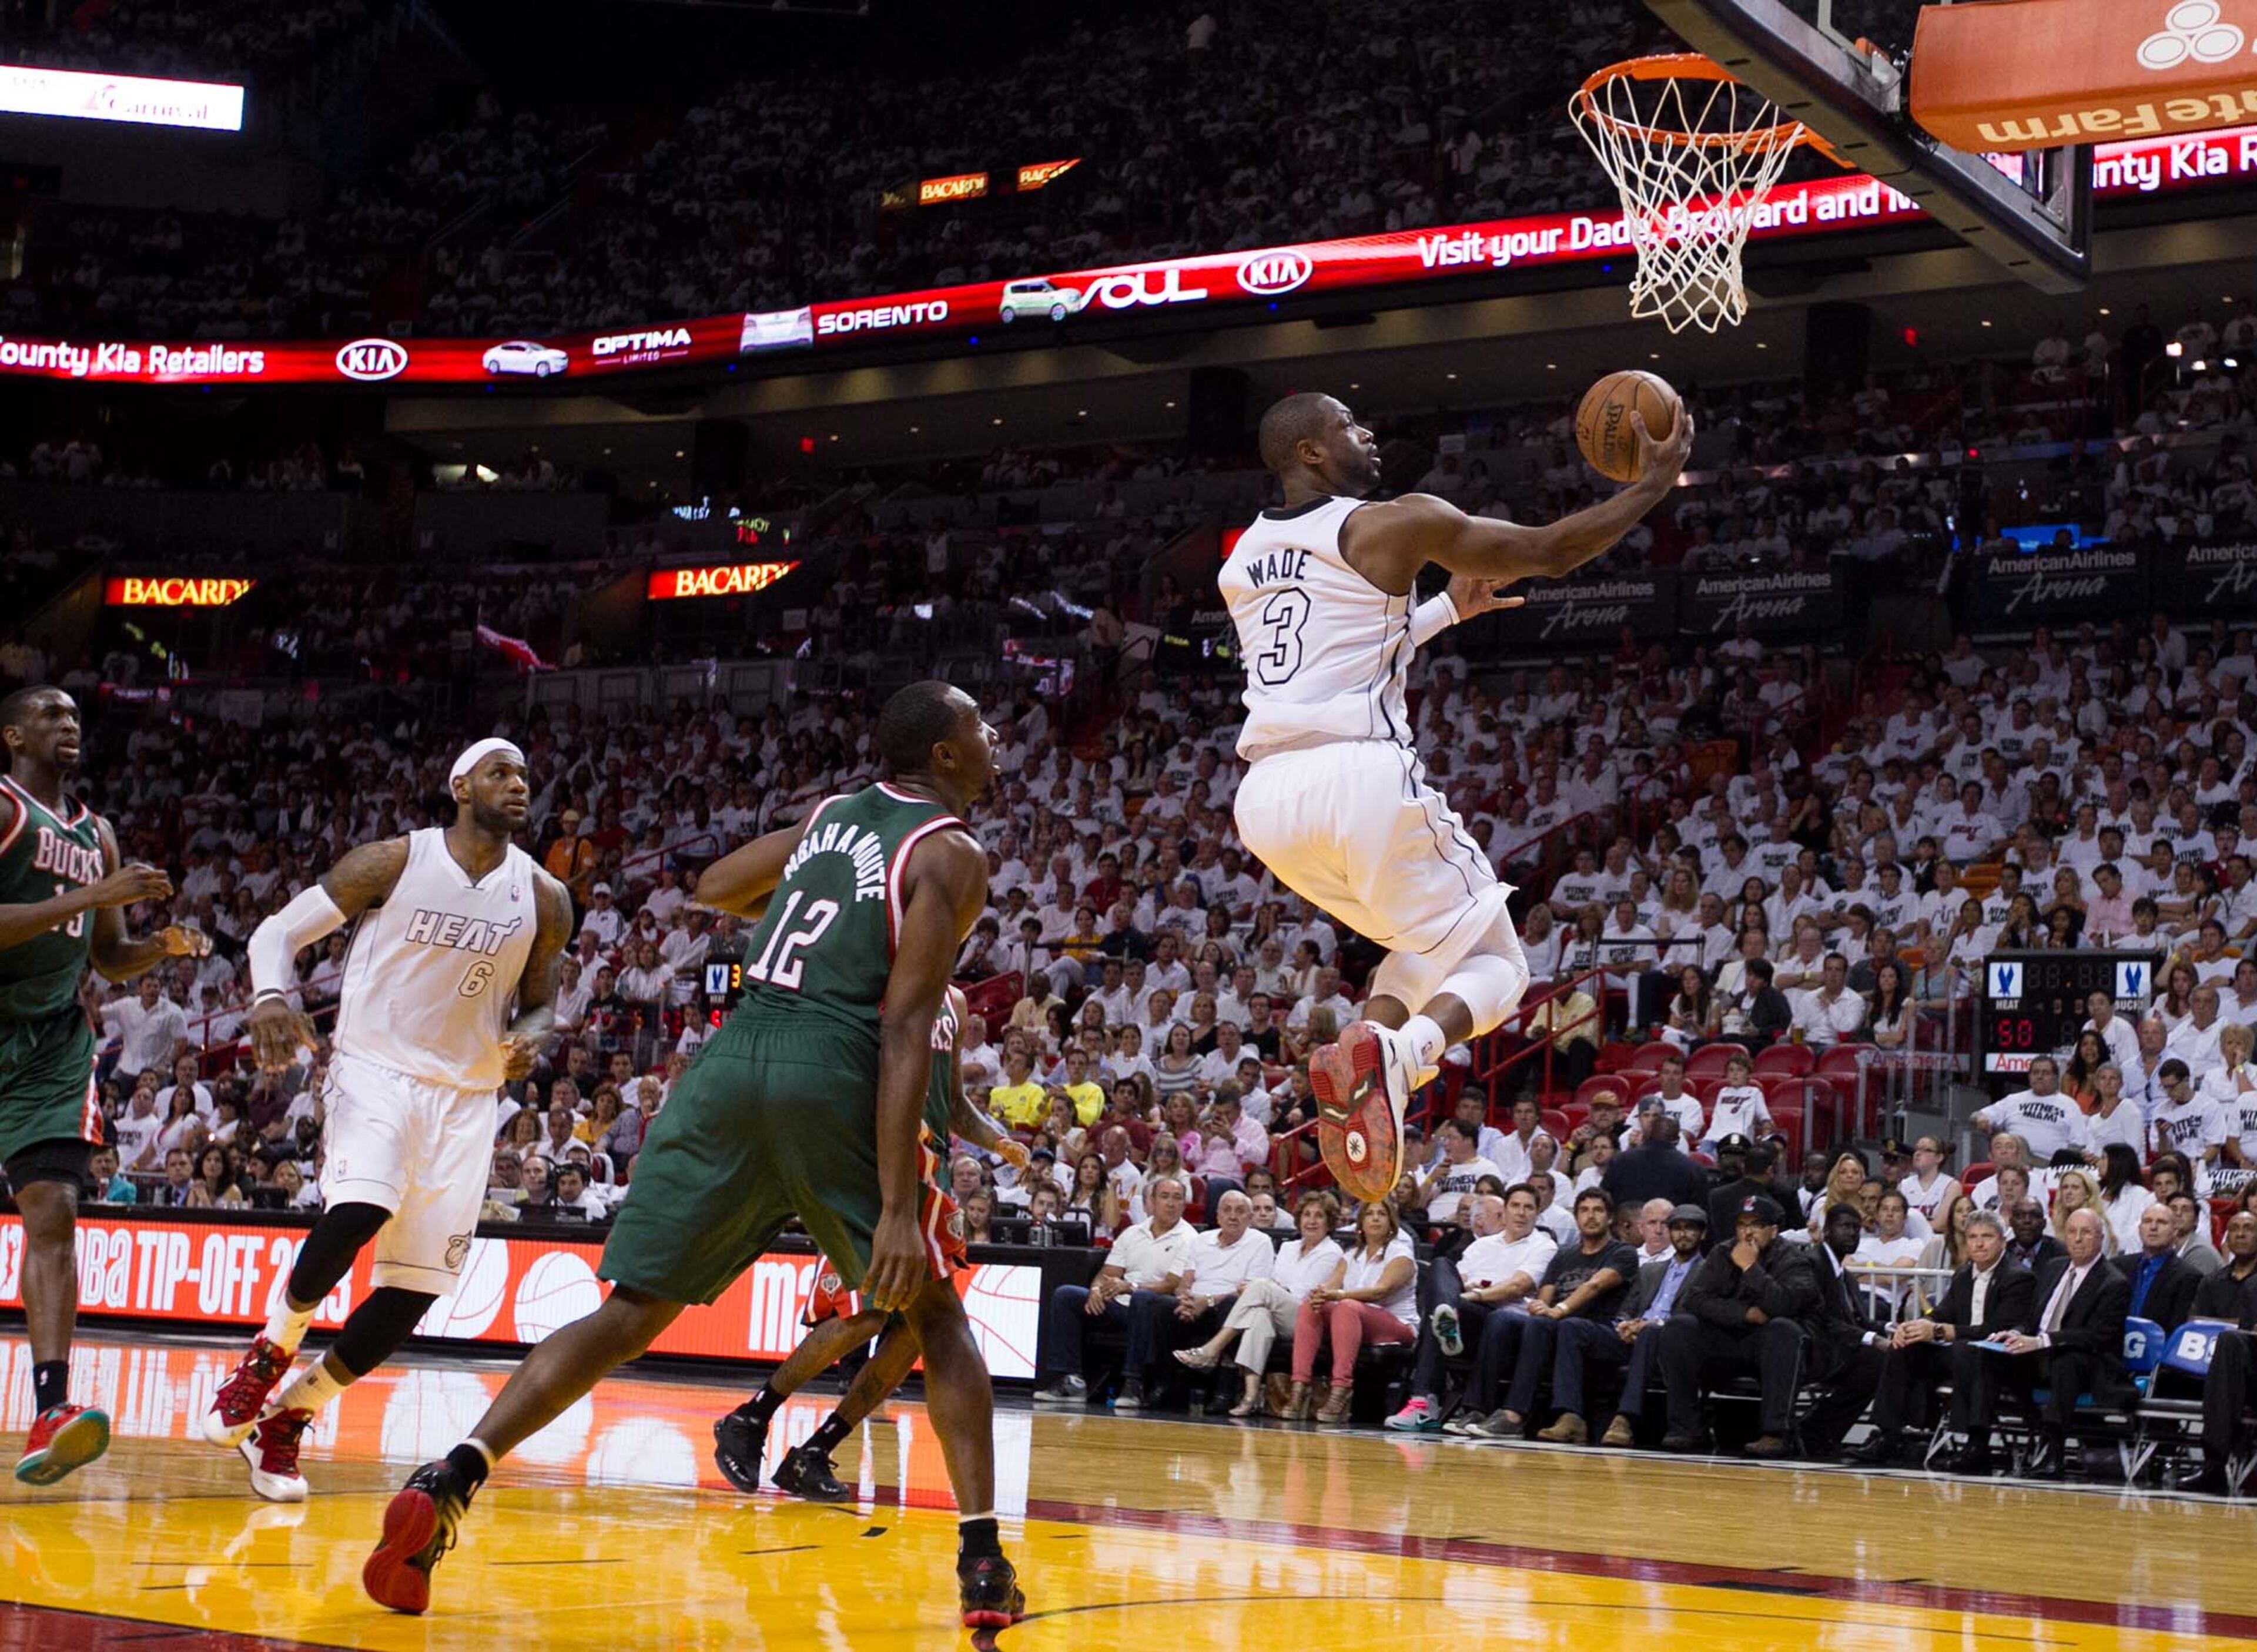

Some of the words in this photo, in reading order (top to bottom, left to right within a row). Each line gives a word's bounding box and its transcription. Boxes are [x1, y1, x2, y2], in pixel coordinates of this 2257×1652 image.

[2093, 152, 2161, 191] nty
[2171, 141, 2228, 179] Kia
[1418, 232, 1485, 267] Visit
[1491, 228, 1563, 267] your
[1816, 182, 1878, 221] and
[1250, 256, 1300, 286] KIA
[818, 300, 949, 334] SORENTO
[0, 336, 89, 377] ounty
[96, 342, 141, 373] Kia
[149, 344, 264, 374] Retailers
[348, 348, 395, 371] KIA
[593, 328, 692, 356] OPTIMA
[1247, 548, 1312, 588] WADE
[1712, 592, 1806, 632] Arena
[2005, 572, 2107, 614] Arena
[1257, 587, 1311, 685] 3
[1540, 599, 1628, 639] Arena
[34, 826, 103, 884] BUCKS
[406, 910, 522, 957] HEAT
[746, 890, 840, 990] 12
[458, 960, 494, 997] 6
[1996, 1000, 2019, 1010] HEAT
[1998, 1018, 2033, 1047] 50
[2019, 1103, 2065, 1118] WITNESS
[2023, 1110, 2058, 1123] MIAMI
[136, 1229, 266, 1315] TIP-OFF
